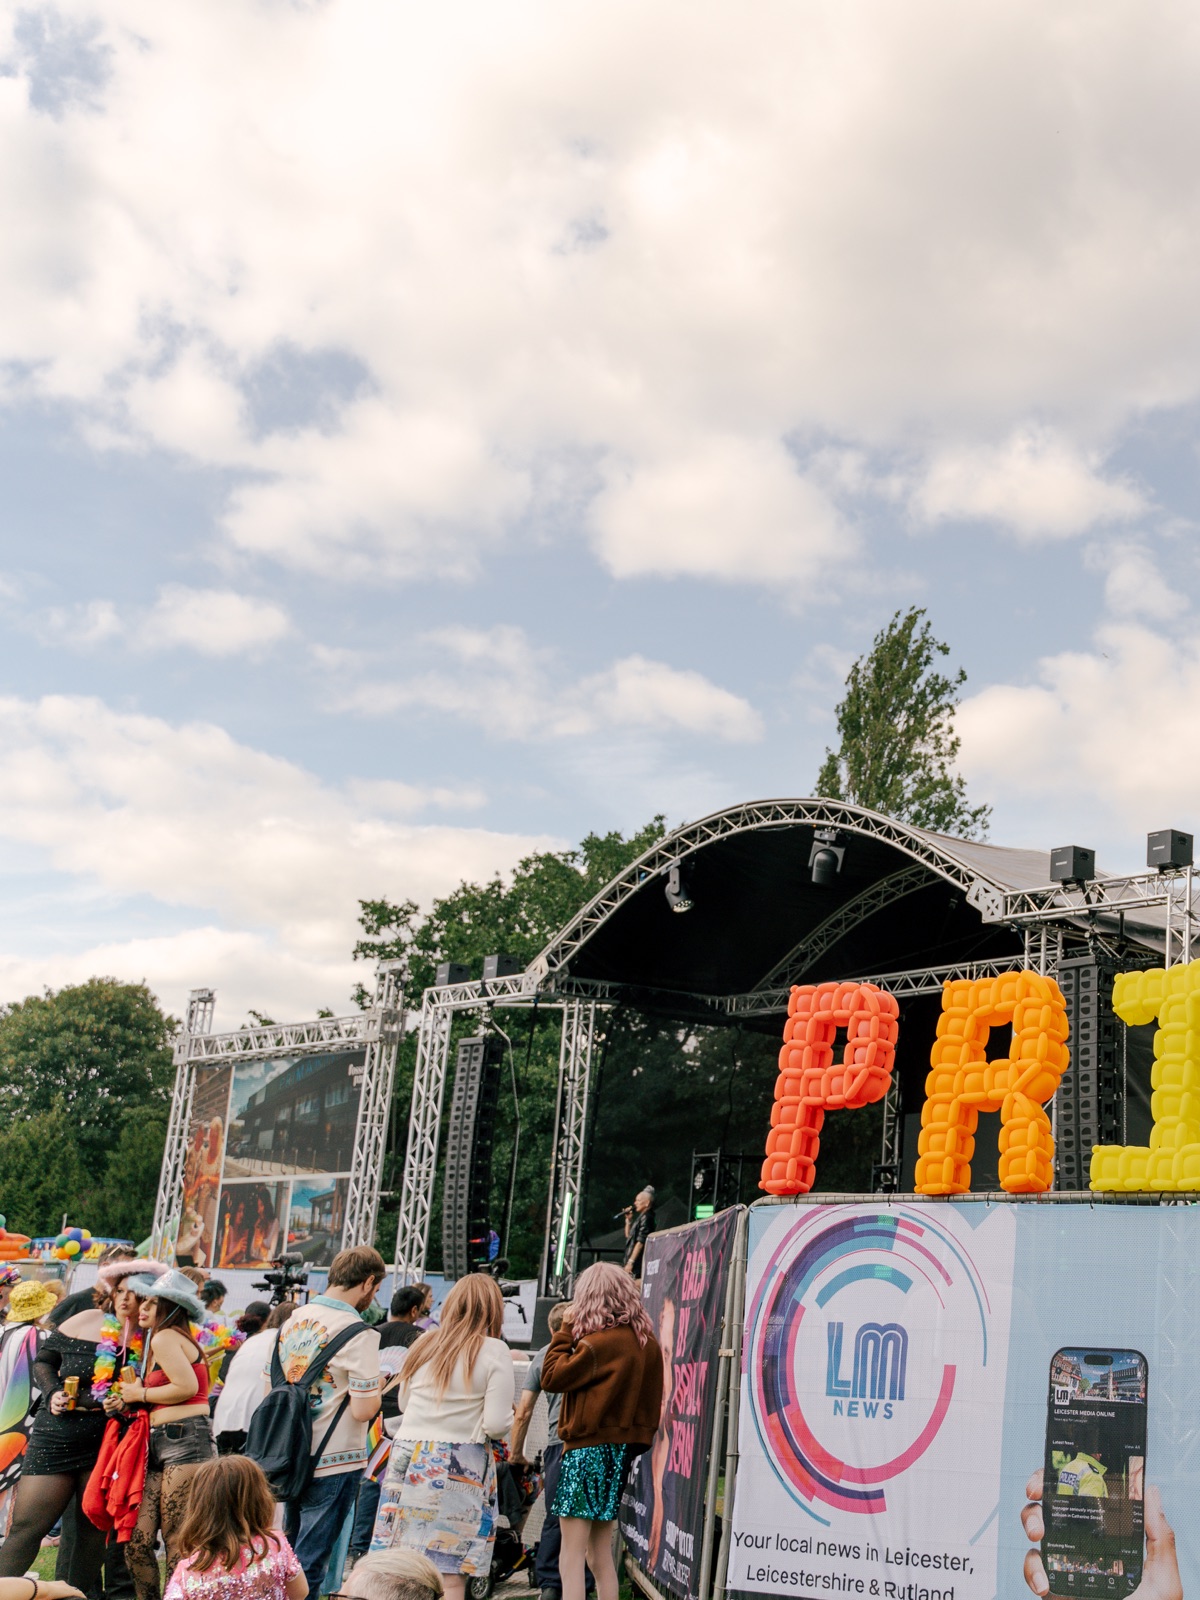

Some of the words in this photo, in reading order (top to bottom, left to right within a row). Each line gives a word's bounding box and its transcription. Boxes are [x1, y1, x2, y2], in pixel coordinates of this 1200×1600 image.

[676, 1307, 691, 1358] BY
[833, 1399, 893, 1420] NEWS
[1054, 1408, 1079, 1416] LEICESTER
[733, 1531, 772, 1550] Your
[775, 1533, 812, 1554] local
[816, 1540, 861, 1560] news
[866, 1543, 879, 1562] in
[885, 1547, 975, 1575] Leicester,
[746, 1565, 865, 1594] Leicestershire
[869, 1579, 881, 1596] &
[884, 1581, 955, 1600] Rutland
